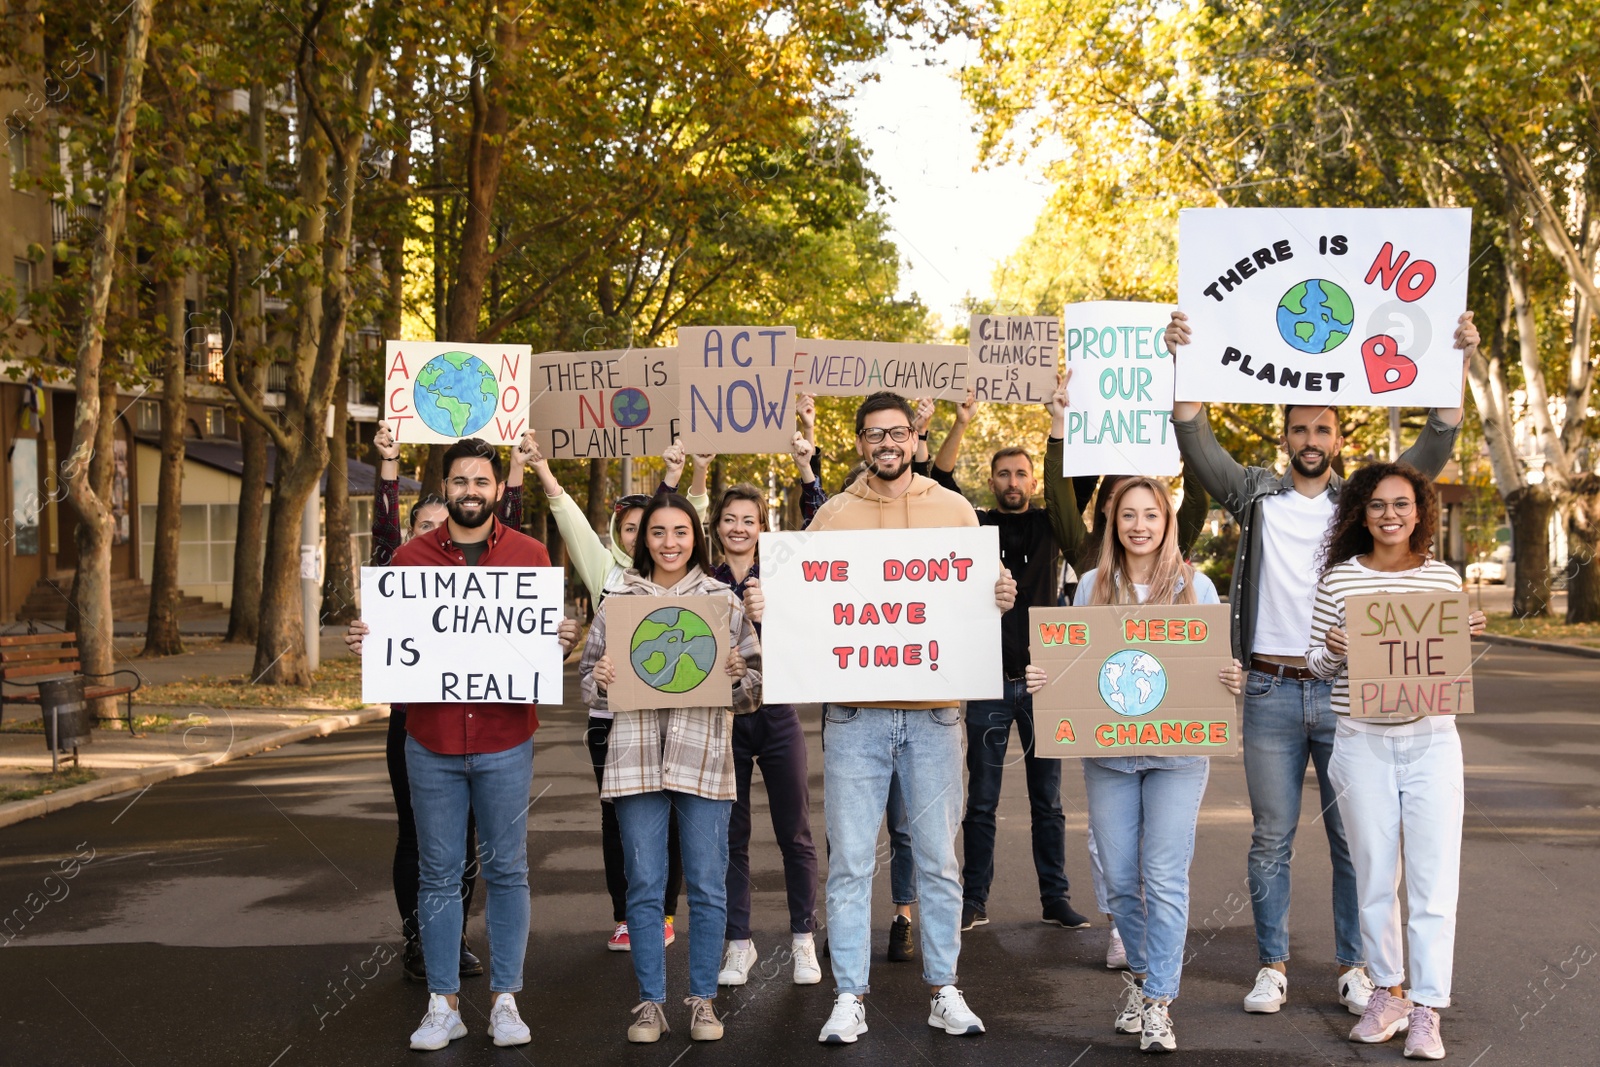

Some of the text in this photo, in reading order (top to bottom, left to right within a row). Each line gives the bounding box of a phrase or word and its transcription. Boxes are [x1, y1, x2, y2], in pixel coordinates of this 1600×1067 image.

[1203, 235, 1437, 303] THERE IS NO
[704, 329, 786, 368] ACT
[978, 345, 1053, 367] CHANGE
[1068, 326, 1170, 361] PROTEC
[539, 360, 623, 391] THERE
[809, 355, 867, 387] NEED
[867, 358, 883, 387] A
[883, 359, 968, 391] CHANGE
[1220, 334, 1418, 394] PLANET B
[388, 351, 413, 441] ACT
[495, 354, 525, 441] NOW
[690, 369, 792, 433] NOW
[975, 377, 1042, 402] REAL
[1099, 367, 1152, 402] OUR
[552, 427, 654, 458] PLANET
[1068, 410, 1173, 445] PLANET
[801, 551, 973, 582] WE DON'T
[378, 571, 538, 600] CLIMATE
[432, 604, 558, 636] CHANGE
[832, 602, 927, 626] HAVE
[1360, 600, 1459, 637] SAVE
[1039, 618, 1208, 646] WE NEED
[386, 637, 421, 667] IS
[832, 639, 939, 671] TIME!
[1379, 638, 1446, 676] THE
[441, 671, 540, 705] REAL!
[1361, 679, 1471, 715] PLANET
[1055, 719, 1229, 747] A CHANGE
